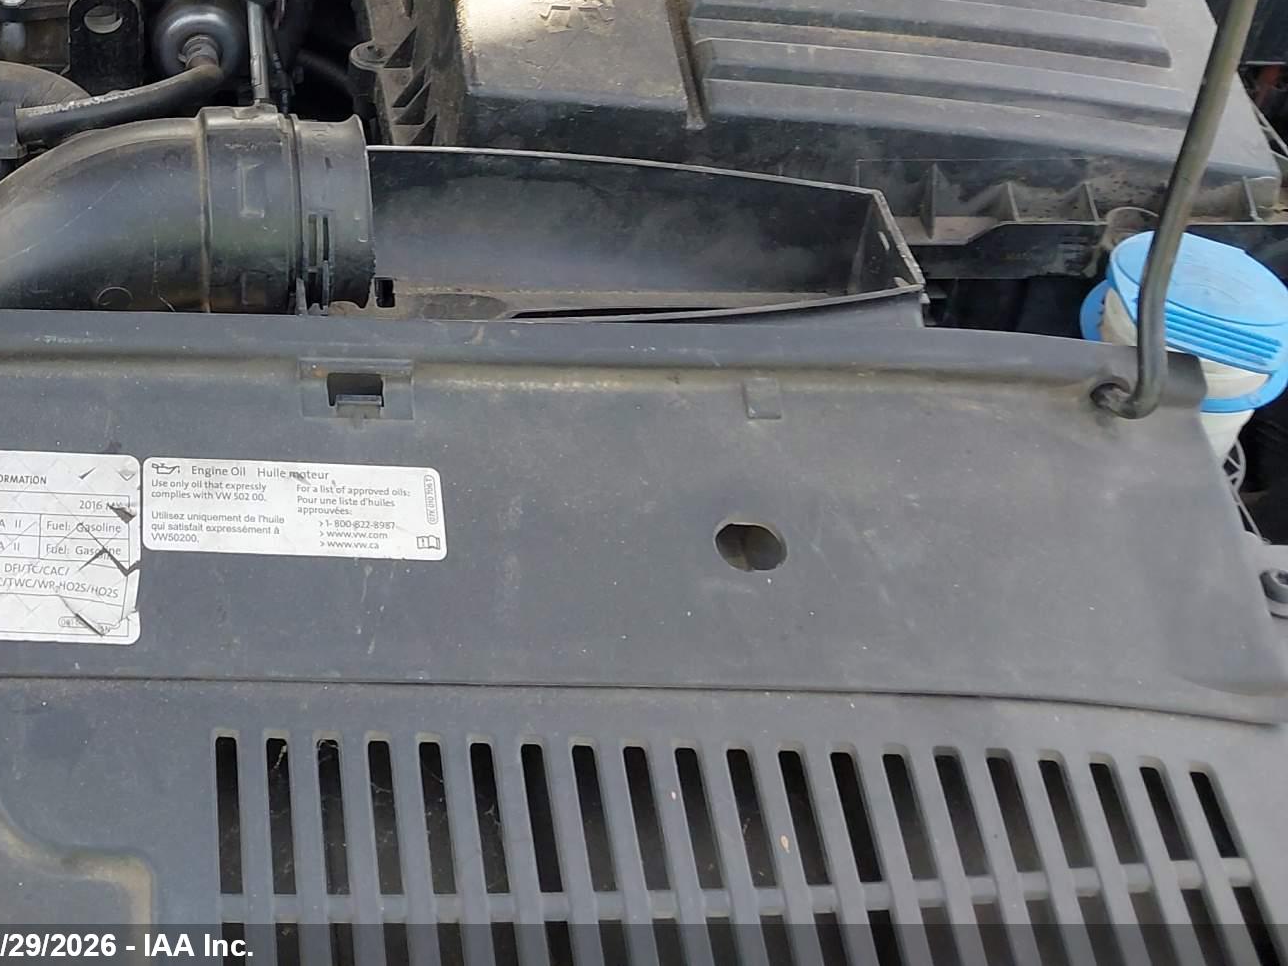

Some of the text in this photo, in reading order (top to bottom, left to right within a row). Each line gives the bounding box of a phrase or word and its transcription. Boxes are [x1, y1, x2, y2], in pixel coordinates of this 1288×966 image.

[192, 466, 329, 480] Engine Oil Huile moteur
[170, 480, 189, 490] only
[192, 480, 202, 488] oil
[204, 481, 223, 489] that
[226, 482, 266, 492] expressly
[297, 484, 310, 493] For
[320, 485, 333, 494] list
[336, 486, 345, 494] of
[348, 487, 389, 497] approved
[392, 488, 410, 496] oils:
[152, 491, 191, 500] complies
[193, 491, 213, 499] with
[216, 492, 232, 500] VW
[252, 494, 266, 502] 00.
[298, 496, 317, 504] Pour
[339, 497, 358, 506] liste
[360, 498, 395, 507] d'huiles
[80, 500, 102, 510] 2016
[152, 511, 184, 520] Utilisez
[187, 513, 242, 523] uniquement
[244, 514, 256, 522] de
[15, 519, 22, 528] II
[46, 520, 122, 533] Fuel: Gasoline
[152, 523, 280, 535] qui satisfait expressément à
[326, 531, 388, 539] www.vw.com
[14, 542, 20, 551] II
[46, 544, 121, 557] Fuel: Gasone
[327, 541, 379, 550] www.vw.ca
[4, 563, 70, 576] DFI/TC/CAC/
